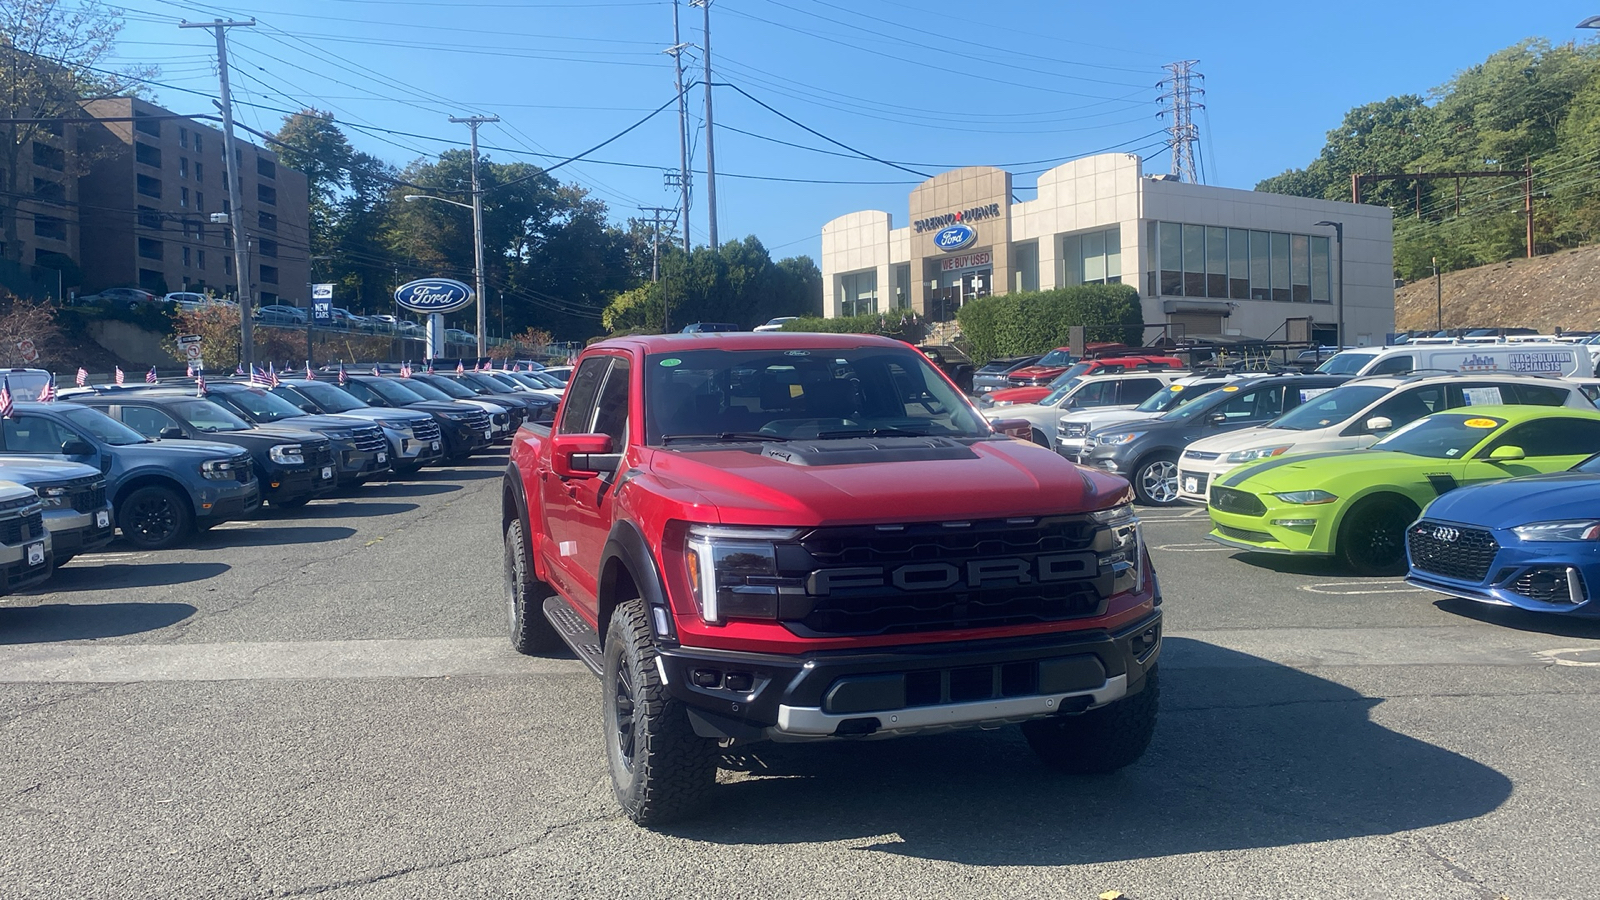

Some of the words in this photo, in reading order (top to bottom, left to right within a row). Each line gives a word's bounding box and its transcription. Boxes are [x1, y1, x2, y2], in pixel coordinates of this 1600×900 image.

[962, 203, 1000, 223] DUANE
[941, 230, 963, 246] Ford
[943, 259, 953, 270] WE
[955, 257, 969, 268] BUY
[970, 253, 990, 266] USED
[410, 285, 454, 304] Ford
[315, 302, 329, 311] NEW
[315, 311, 329, 319] CARS
[1508, 353, 1531, 363] HVAC
[1531, 352, 1571, 363] SOLUTION
[1509, 362, 1561, 372] SPECIALISTS
[806, 553, 1098, 595] FORD
